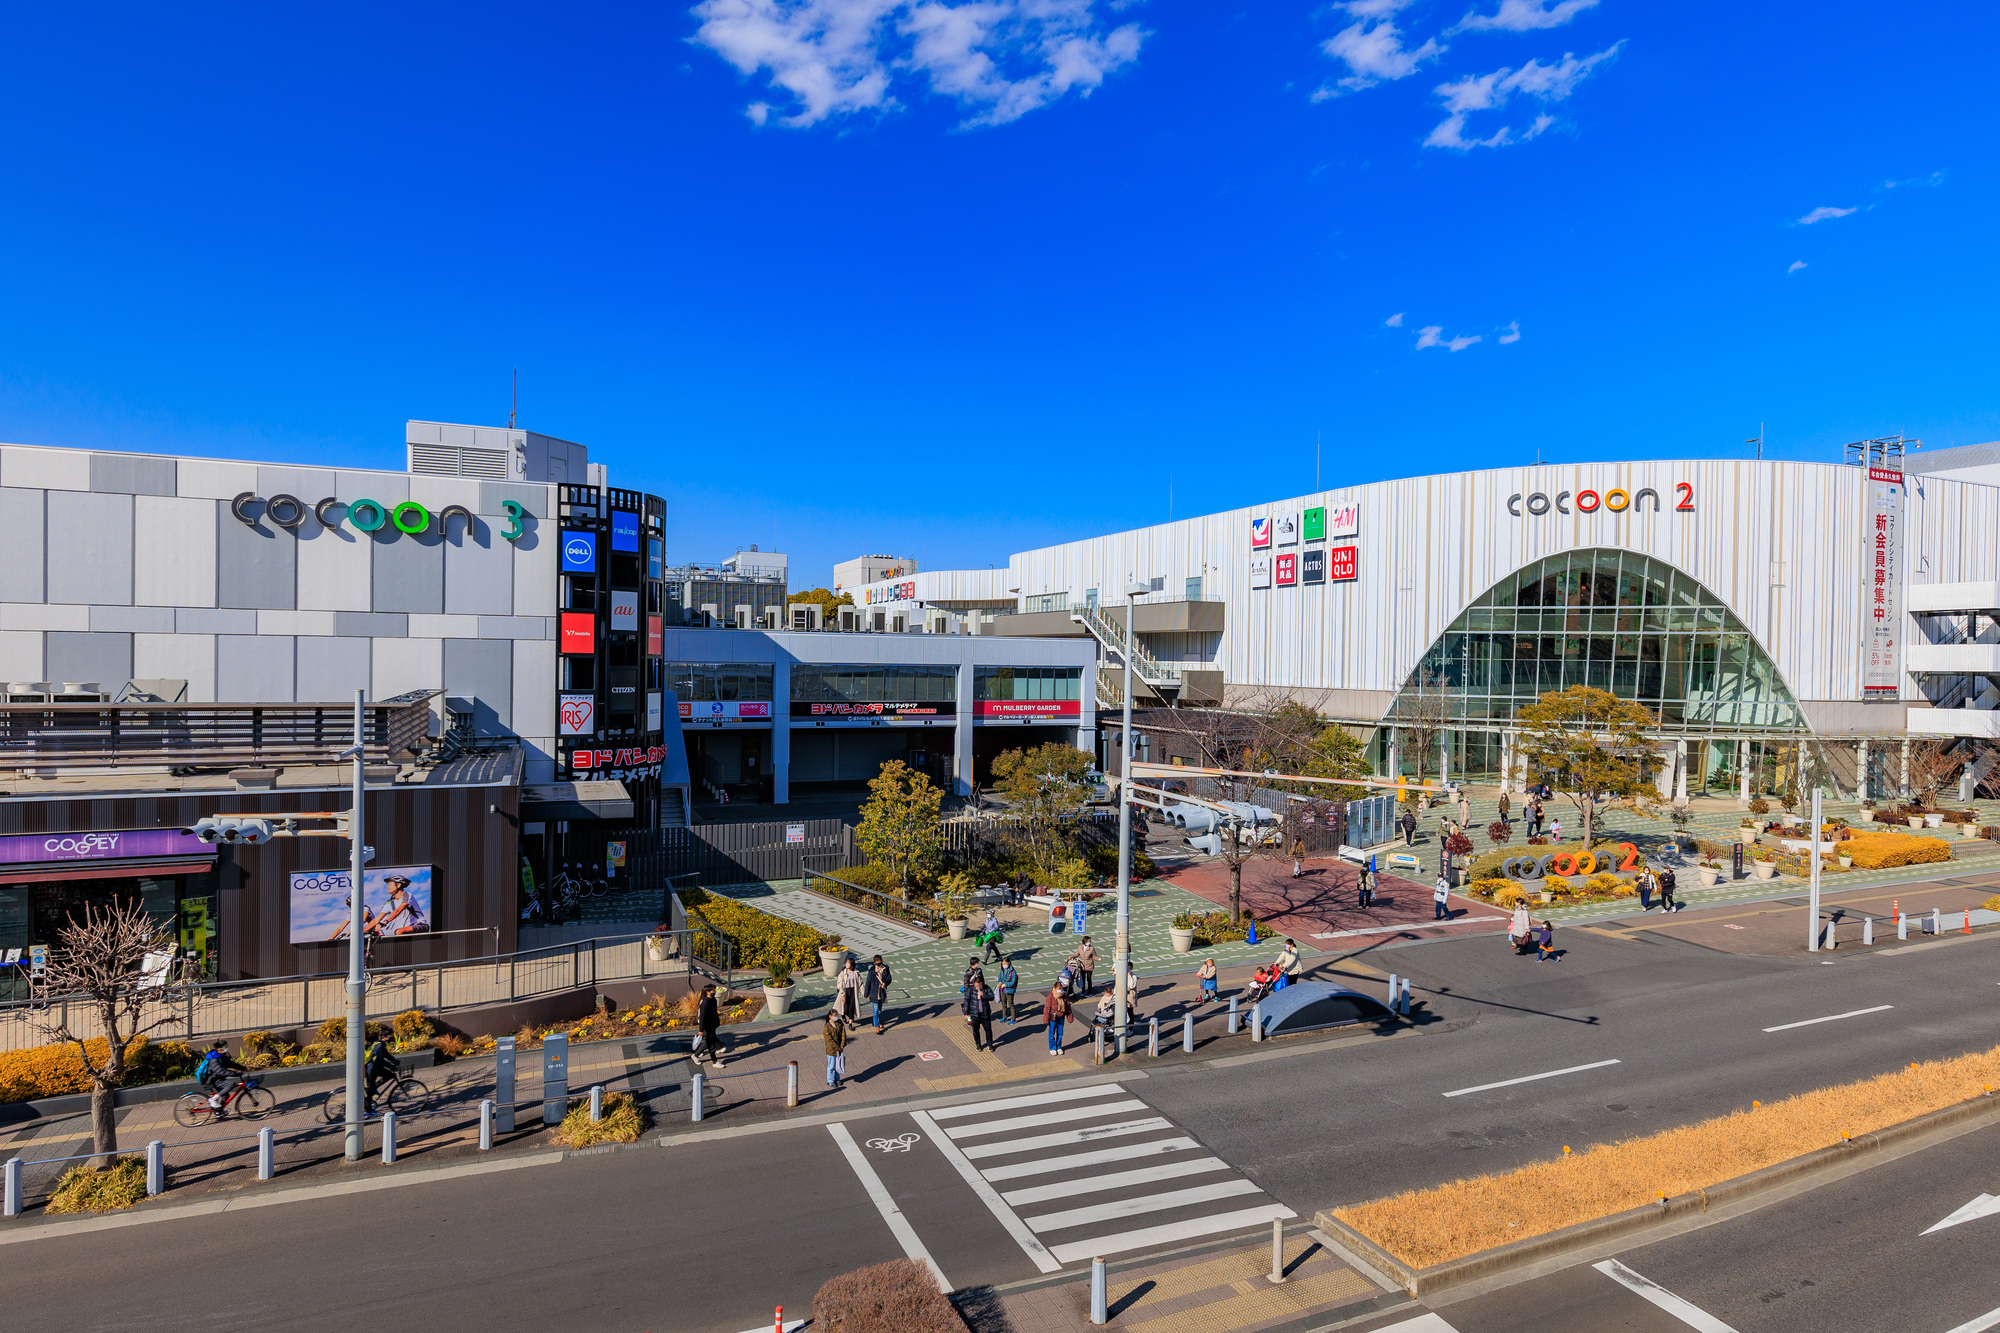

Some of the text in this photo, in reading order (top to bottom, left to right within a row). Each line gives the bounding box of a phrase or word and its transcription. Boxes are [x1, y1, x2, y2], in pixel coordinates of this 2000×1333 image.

[1507, 482, 1695, 517] cocoon 2
[231, 491, 523, 539] cocoon 3
[1333, 507, 1356, 529] H&M
[1304, 560, 1322, 571] ACTUS
[1334, 550, 1352, 562] UNI
[1333, 563, 1353, 577] QLO
[1873, 513, 1887, 622] 新会員募集中
[613, 605, 635, 616] au
[811, 703, 884, 715] ヨドバシカメラ
[572, 744, 668, 769] ヨドバシカメ
[44, 833, 119, 854] COGGEY
[1501, 841, 1639, 881] cocoon 2
